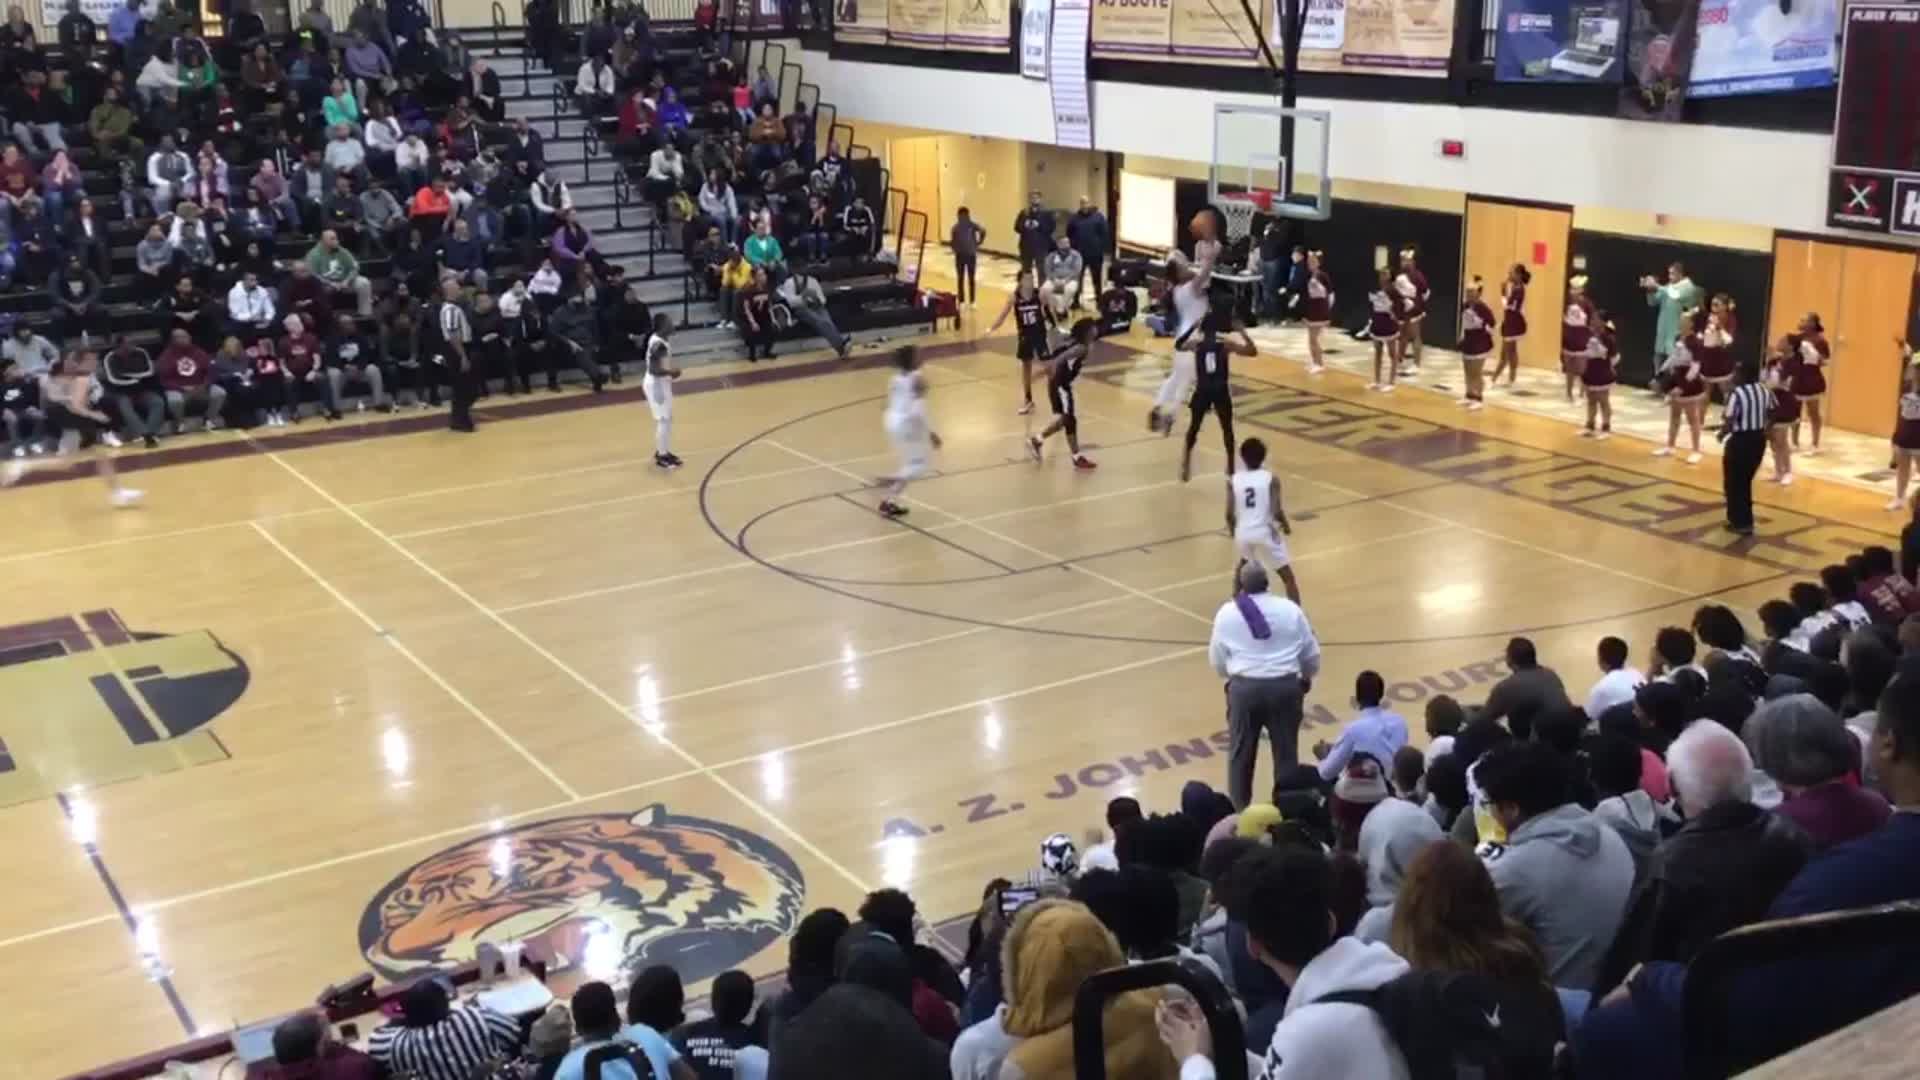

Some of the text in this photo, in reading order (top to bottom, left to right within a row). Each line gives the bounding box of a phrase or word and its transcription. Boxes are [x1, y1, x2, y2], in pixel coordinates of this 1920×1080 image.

[1851, 10, 1886, 21] PLAYER
[1245, 487, 1256, 509] 2
[958, 793, 1026, 823] Z.
